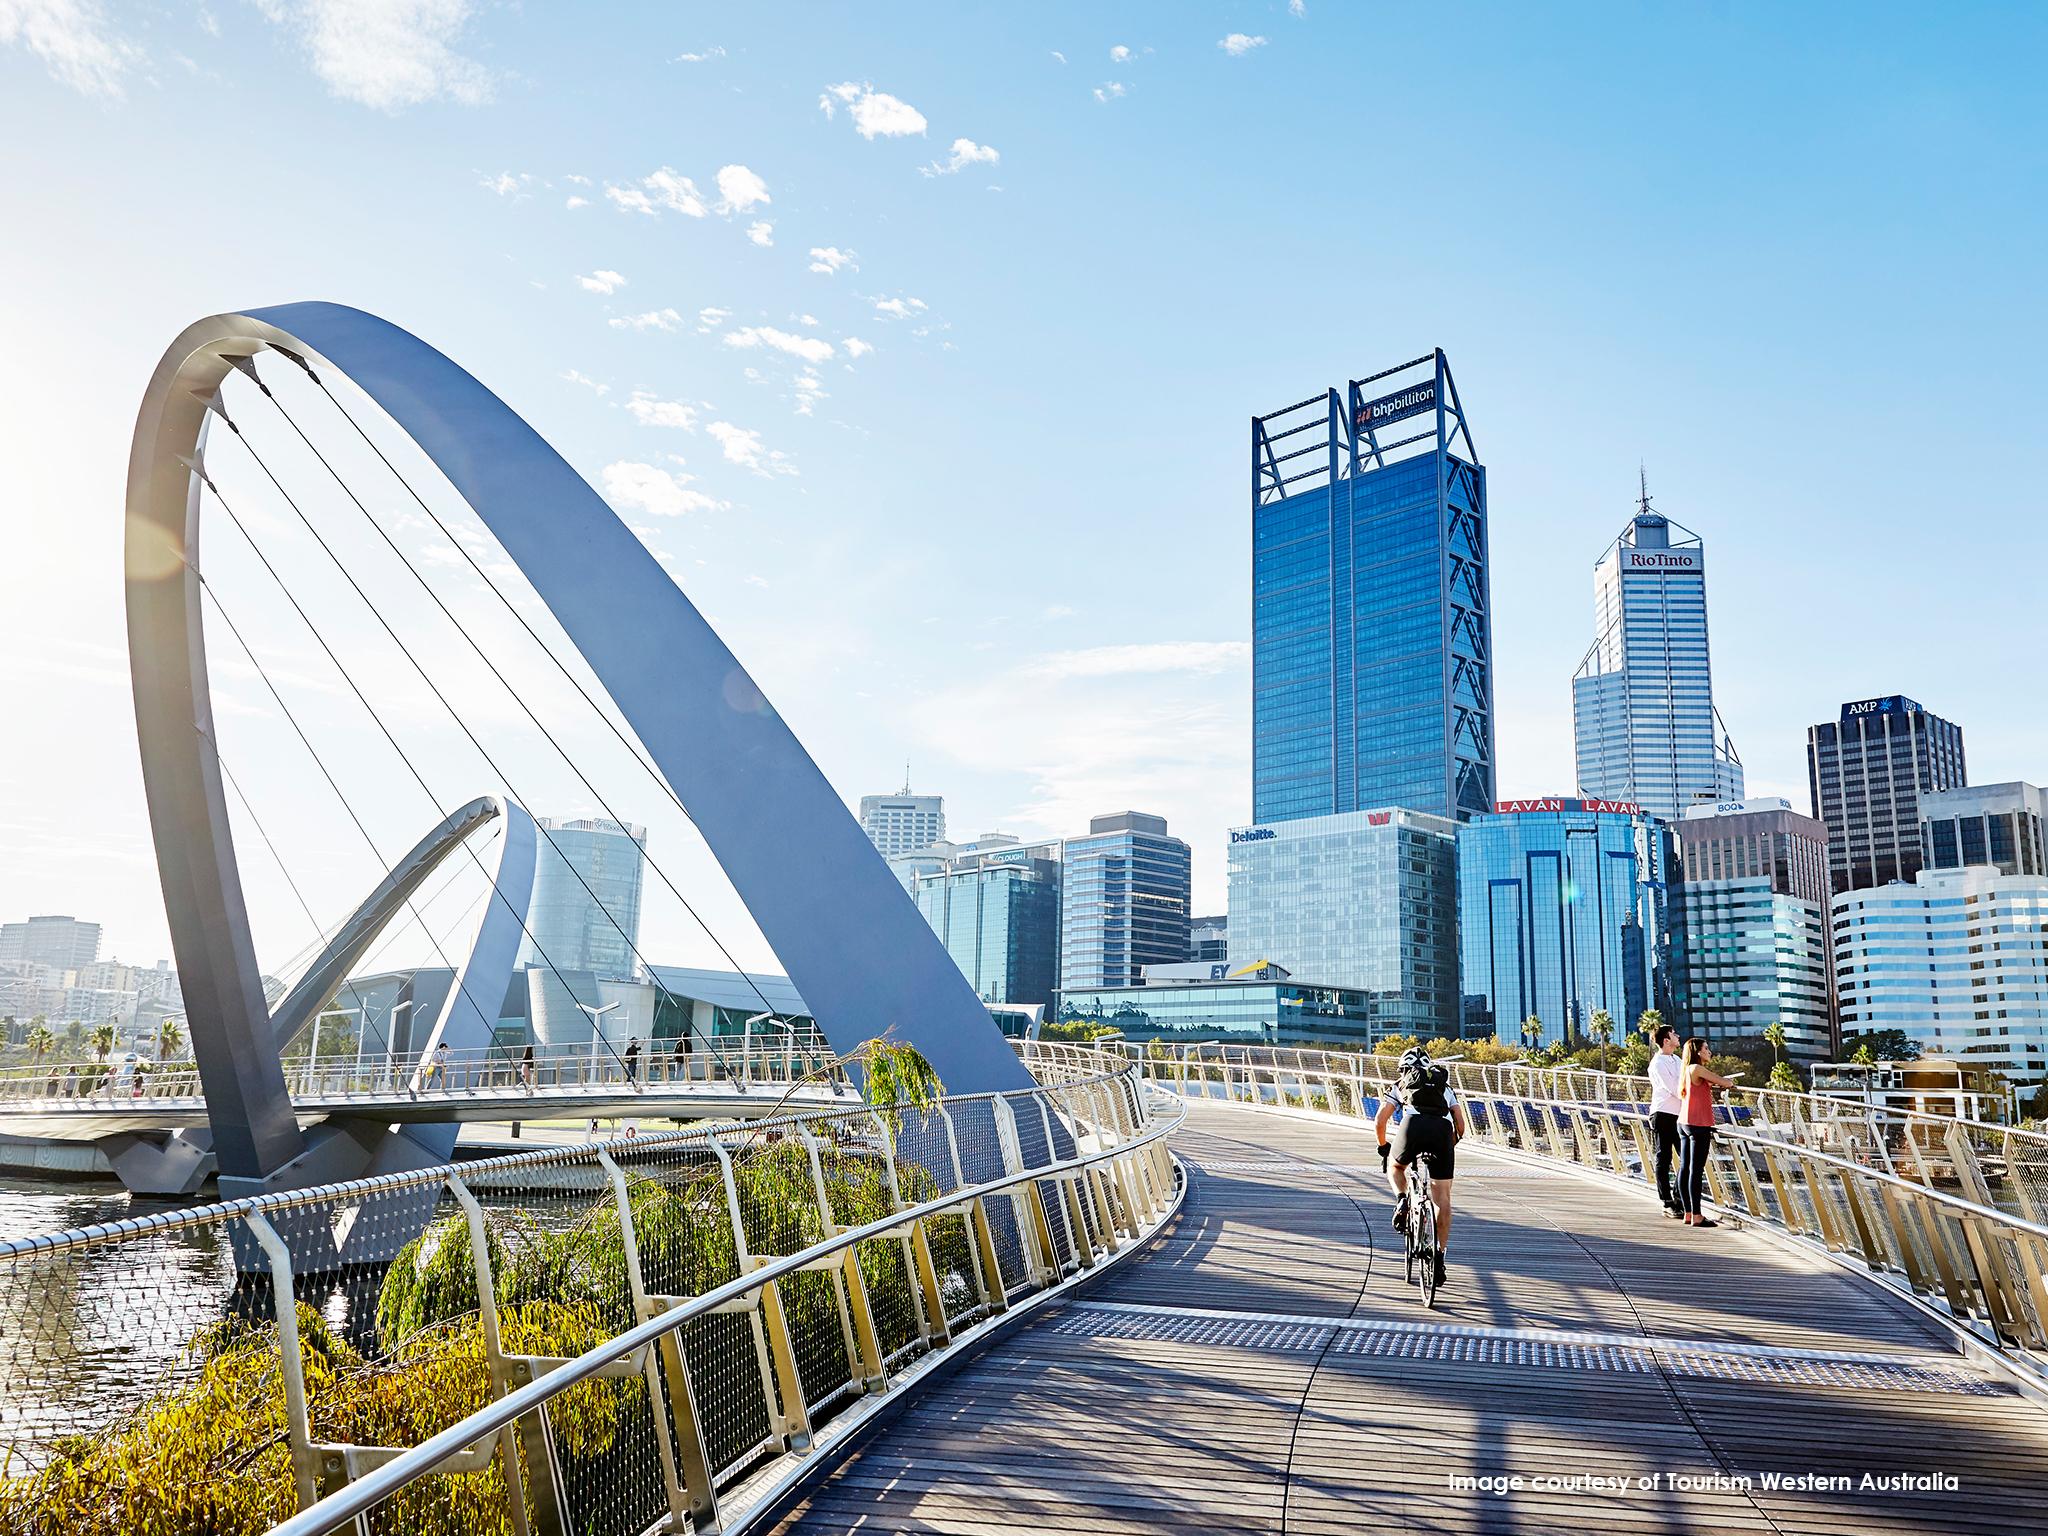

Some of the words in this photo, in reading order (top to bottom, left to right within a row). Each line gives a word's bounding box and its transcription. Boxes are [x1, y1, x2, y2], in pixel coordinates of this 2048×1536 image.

[1373, 389, 1434, 418] bhpbilliton
[1849, 701, 1877, 714] AMP
[1498, 801, 1560, 812] LAVAN
[1586, 801, 1638, 814] LAVAN
[1718, 803, 1737, 812] BOQ
[998, 853, 1022, 862] CLOUGH
[1211, 964, 1230, 979] EY
